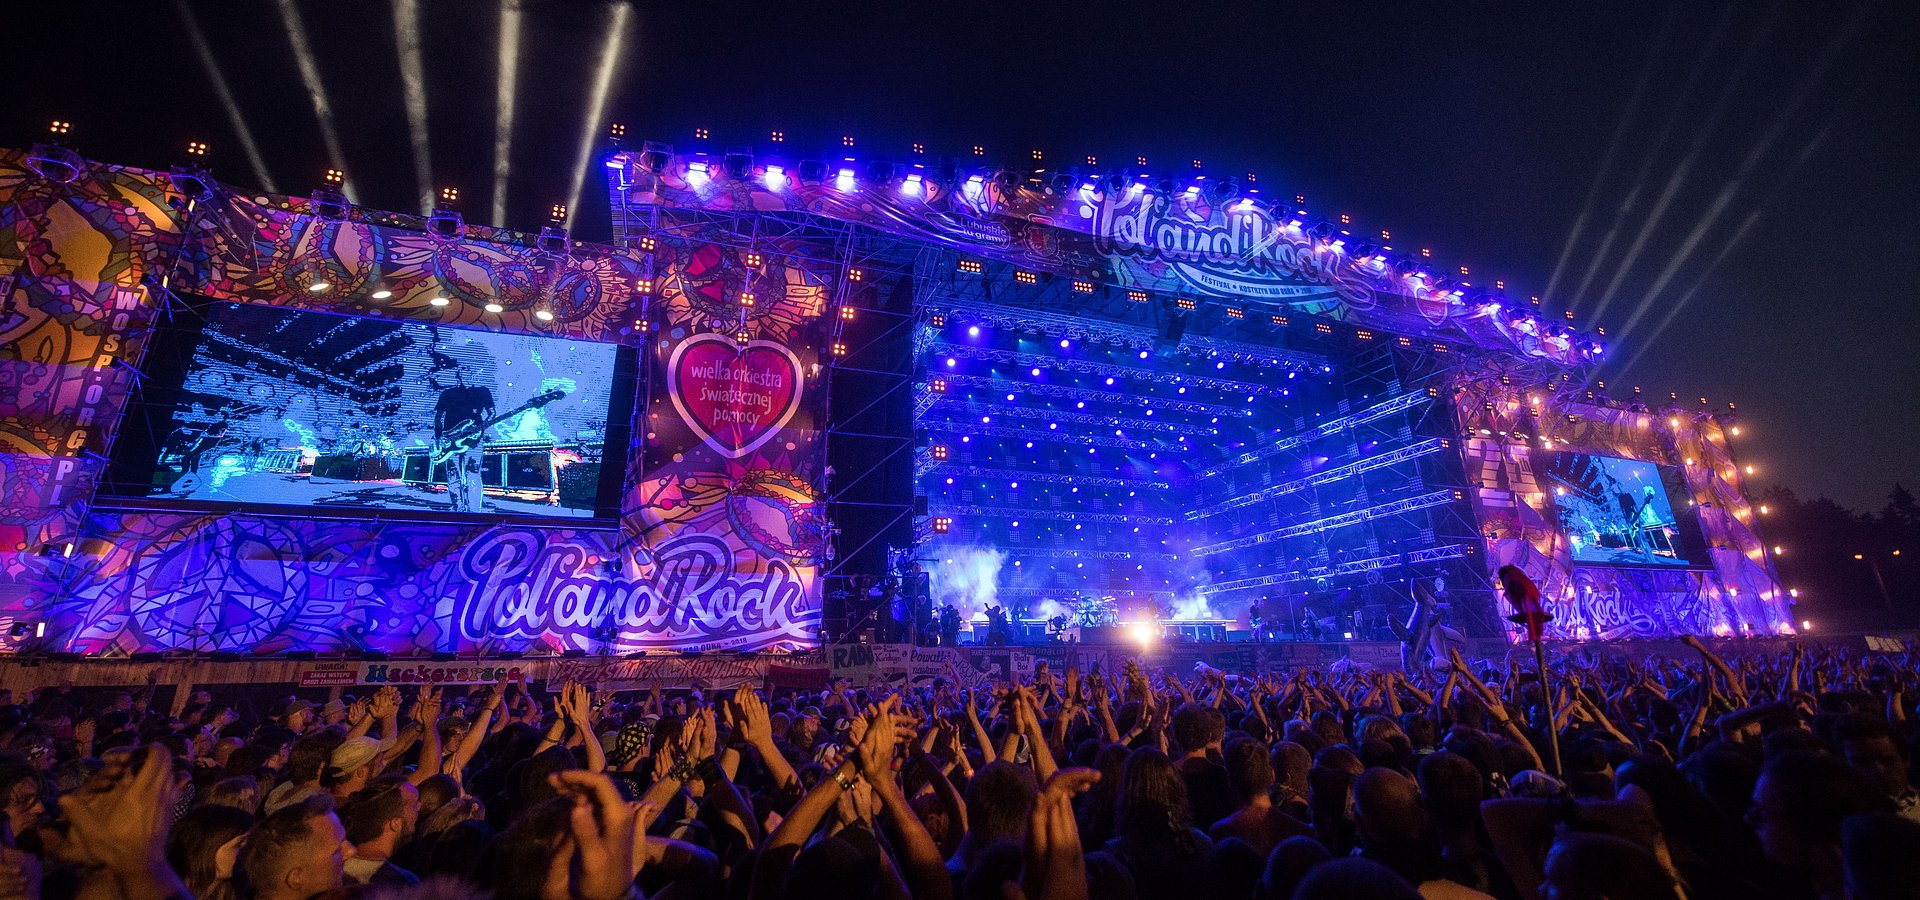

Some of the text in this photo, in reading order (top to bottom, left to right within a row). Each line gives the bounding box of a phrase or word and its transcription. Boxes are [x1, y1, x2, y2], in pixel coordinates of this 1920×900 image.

[960, 217, 1007, 237] Lubuskie
[975, 231, 1007, 246] gramy
[1201, 275, 1231, 290] FESTIVAL
[1240, 285, 1268, 295] KOSTRZYN
[1269, 287, 1280, 295] NAD
[691, 360, 782, 388] wielka orkiestra
[699, 382, 772, 415] świątecznej
[713, 408, 761, 431] pomocy
[731, 637, 748, 646] 2018
[314, 663, 349, 671] UWAGA!
[364, 664, 525, 683] Hackerspace
